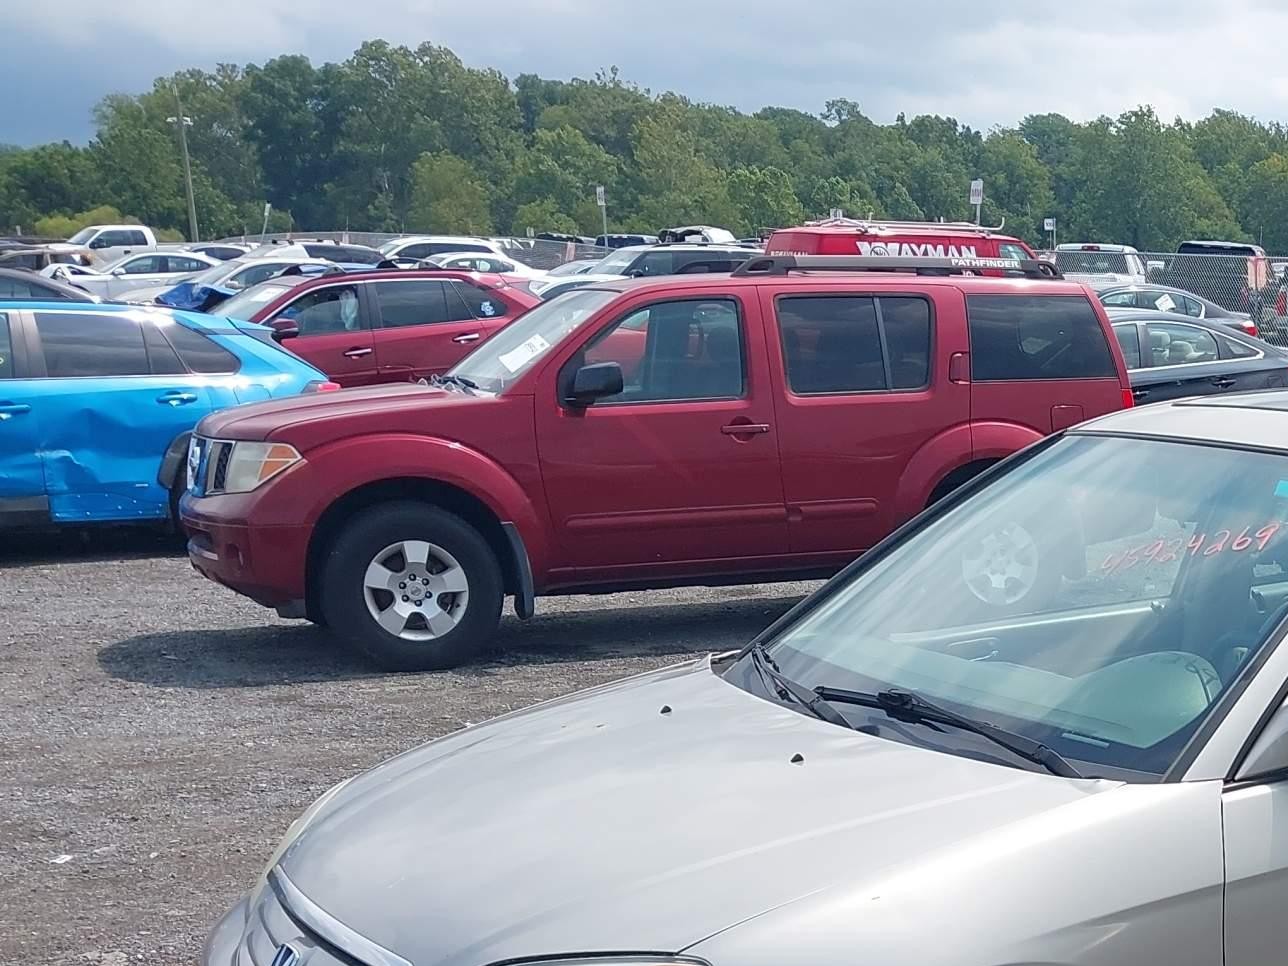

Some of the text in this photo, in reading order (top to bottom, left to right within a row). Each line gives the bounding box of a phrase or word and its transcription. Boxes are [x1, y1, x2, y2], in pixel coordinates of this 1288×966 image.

[856, 241, 977, 259] WAYMAN
[951, 258, 1020, 268] PATHFINDER
[1101, 520, 1281, 577] 45924269
